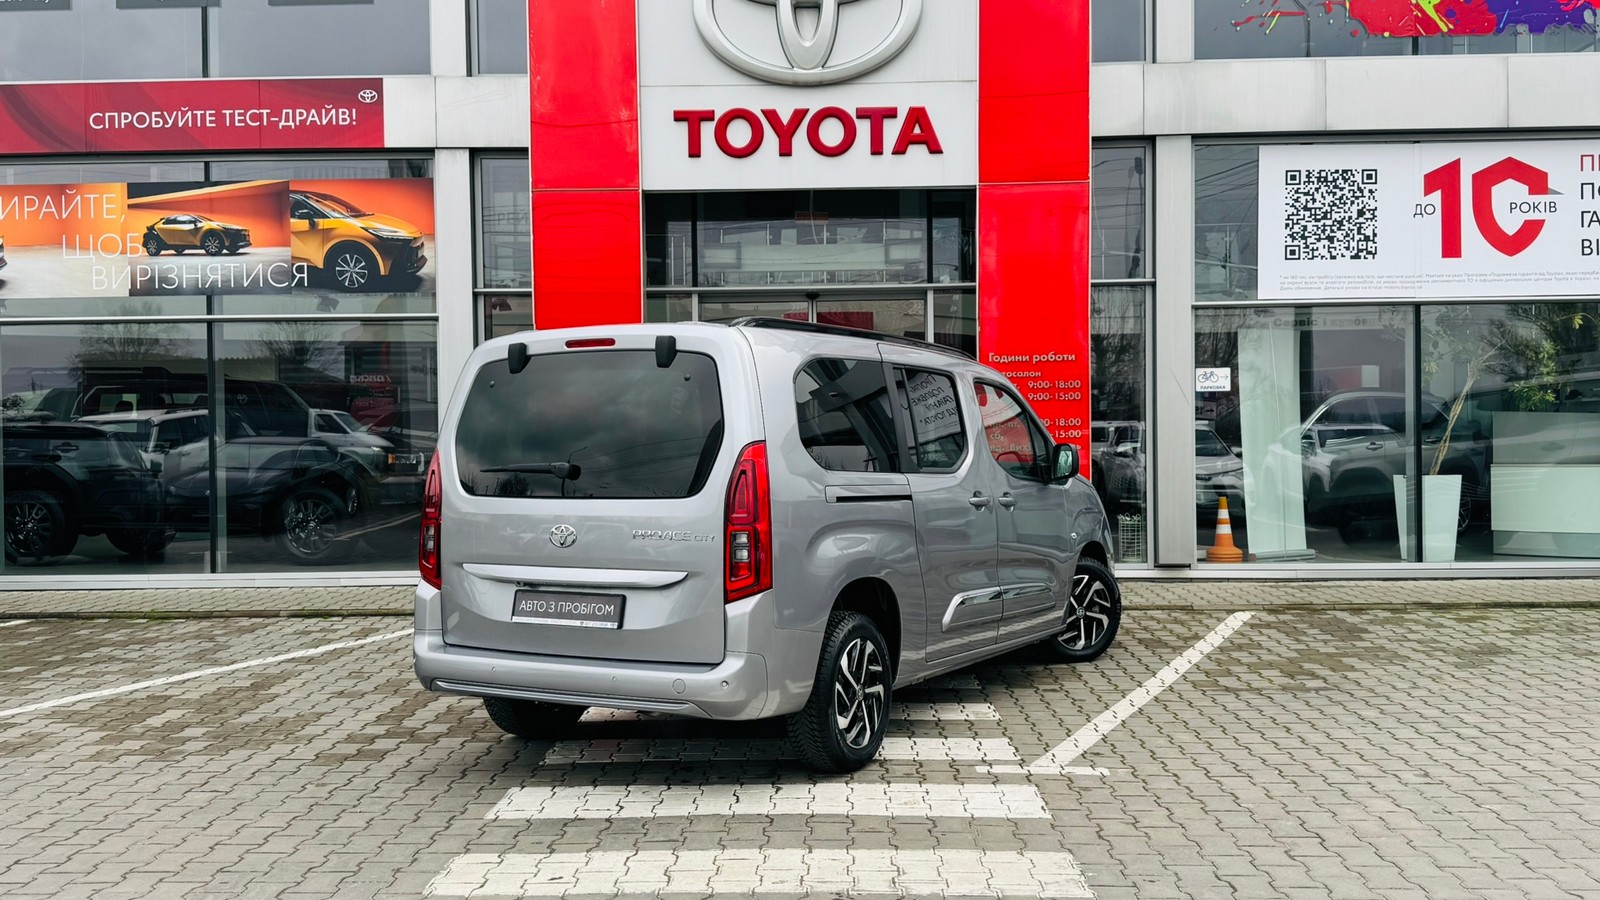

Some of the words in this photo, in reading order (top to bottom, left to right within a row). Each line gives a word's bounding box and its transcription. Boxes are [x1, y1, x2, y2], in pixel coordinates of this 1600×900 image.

[89, 107, 216, 129] СПРОБУЙТЕ
[222, 104, 358, 129] ТЕСТ-ДРАЙВ!
[673, 106, 944, 158] TOYOTA
[1413, 203, 1436, 218] ДО
[1509, 201, 1557, 214] РОКІВ
[62, 233, 143, 263] ЩОБ
[92, 262, 309, 290] ВИРІЗНЯТИСЯ
[988, 352, 1030, 363] Години
[1032, 351, 1076, 364] роботи
[632, 529, 692, 541] PROACE
[694, 534, 716, 542] CITY
[519, 600, 547, 611] АВТО
[548, 602, 555, 611] З
[557, 602, 615, 616] ПРОБІГОМ
